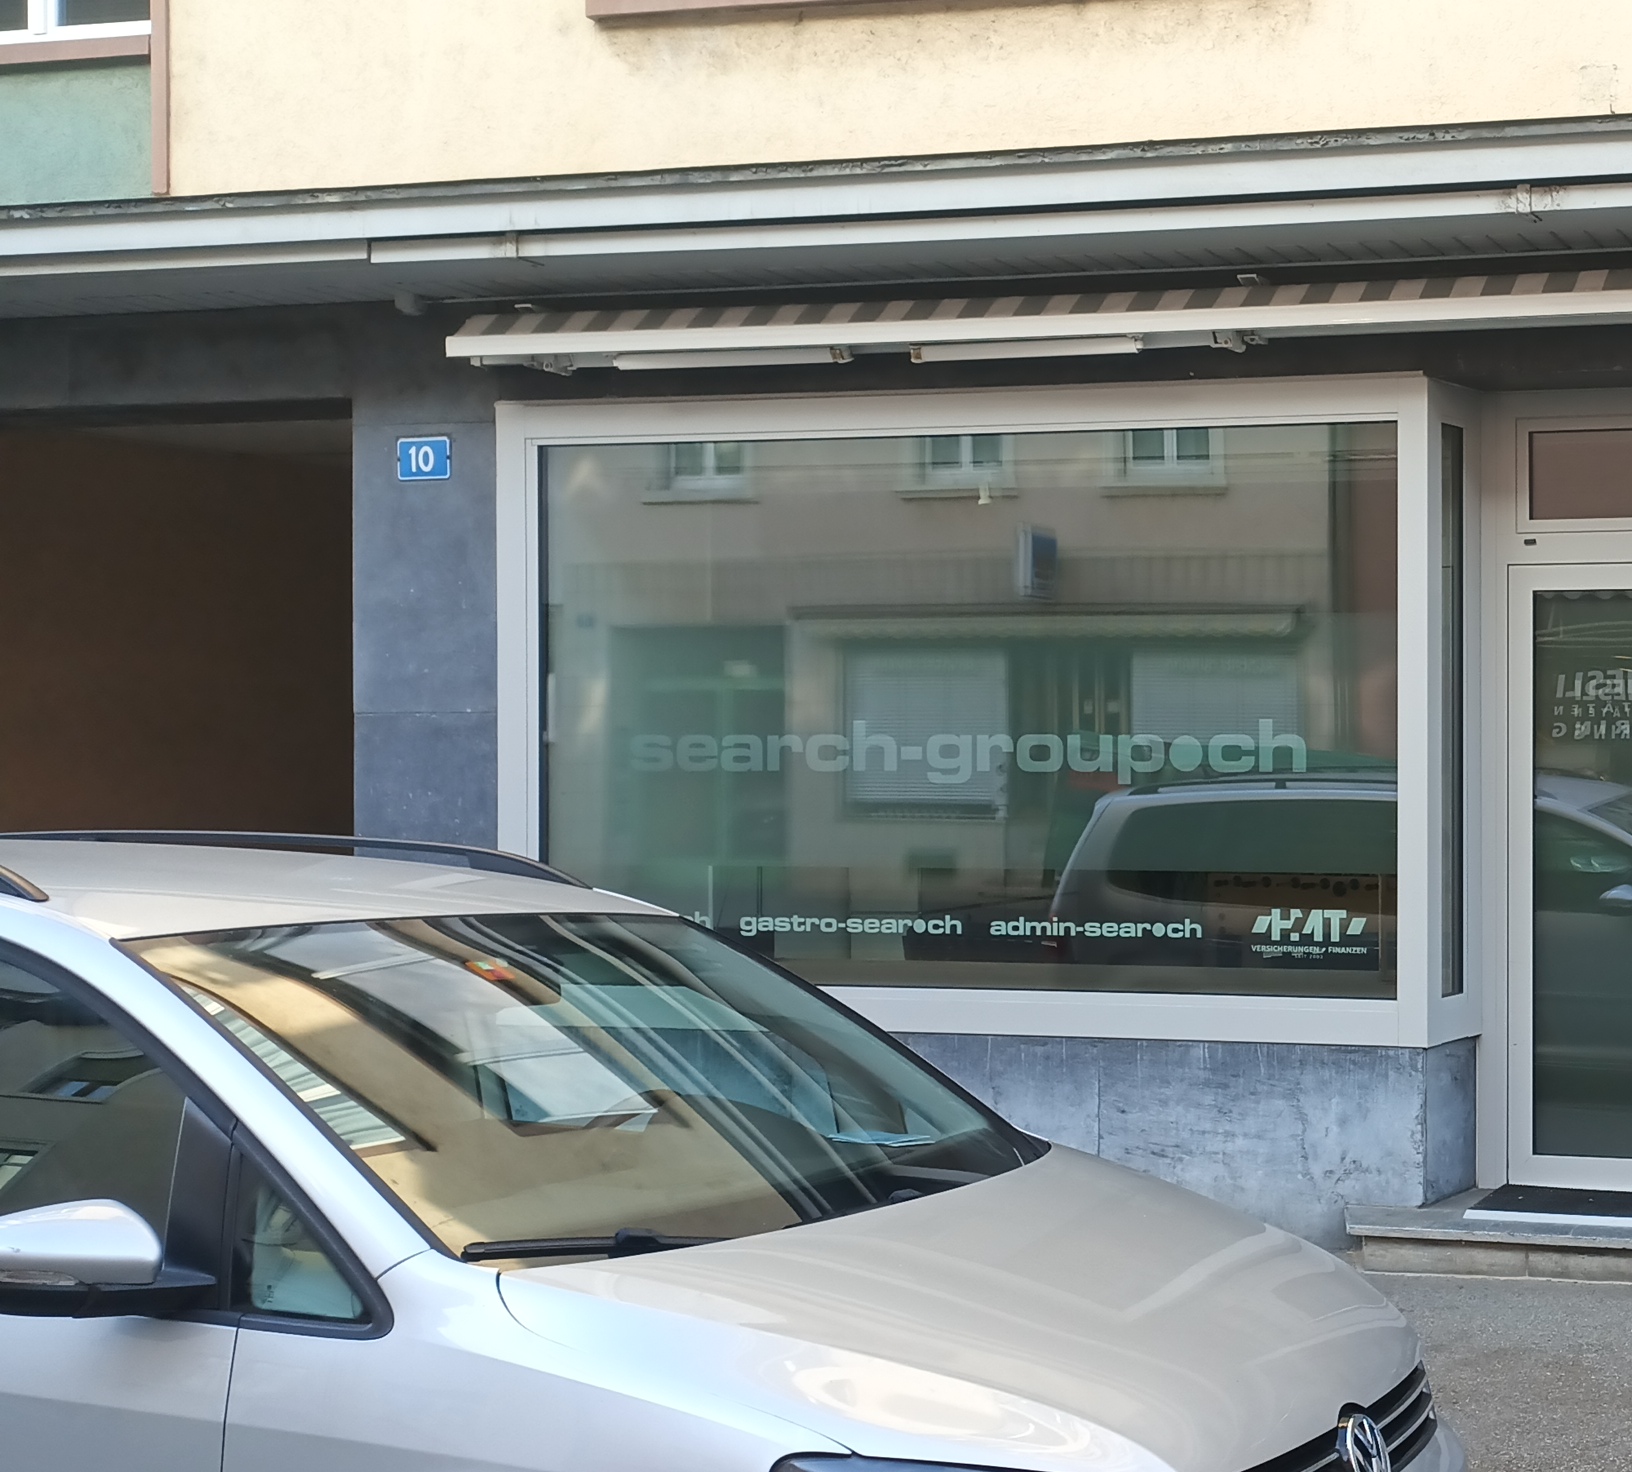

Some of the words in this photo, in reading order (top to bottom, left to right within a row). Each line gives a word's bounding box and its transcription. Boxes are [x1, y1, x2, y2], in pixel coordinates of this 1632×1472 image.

[408, 445, 434, 472] 10
[1251, 944, 1320, 954] VERSICHERUNGEN
[1328, 946, 1367, 954] FINANZEN
